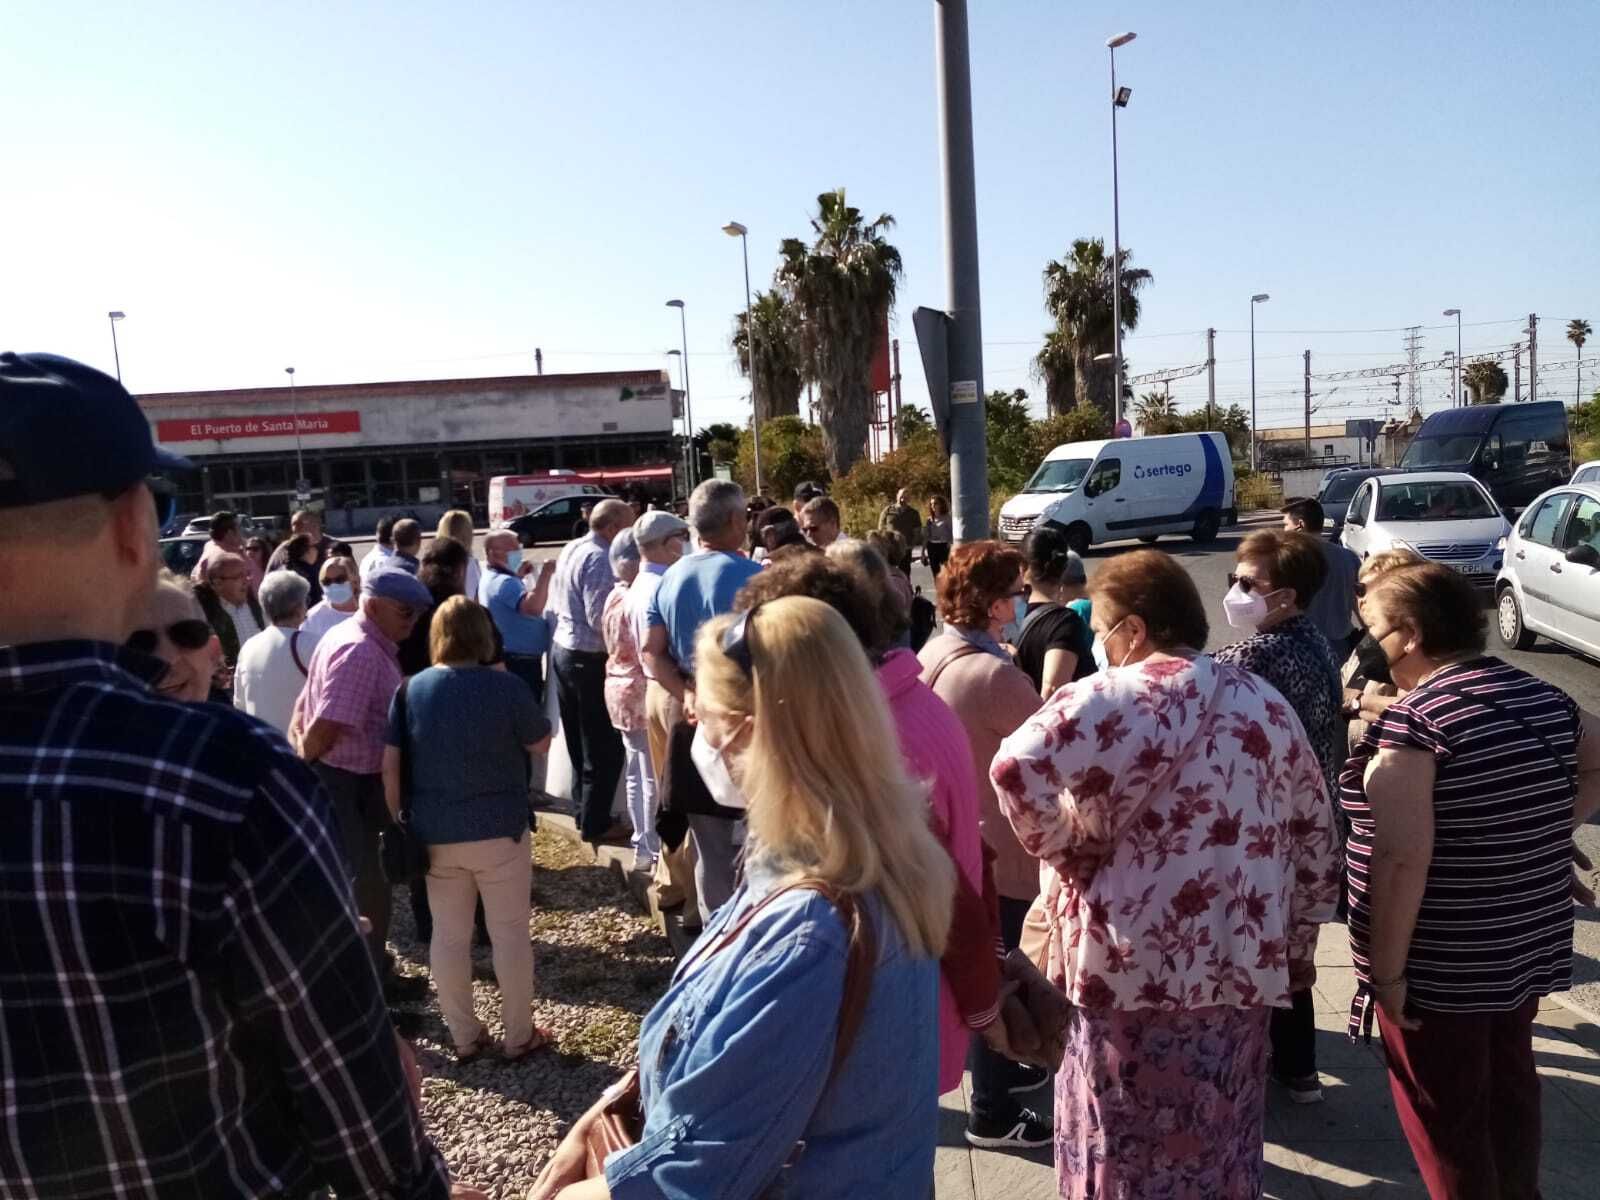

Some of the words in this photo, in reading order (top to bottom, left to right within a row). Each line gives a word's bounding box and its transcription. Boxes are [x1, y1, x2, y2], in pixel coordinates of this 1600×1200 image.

[191, 424, 202, 435] El
[205, 423, 242, 435] Puerto
[245, 421, 258, 433] de
[262, 420, 293, 432] Santa
[1147, 463, 1192, 478] sertego
